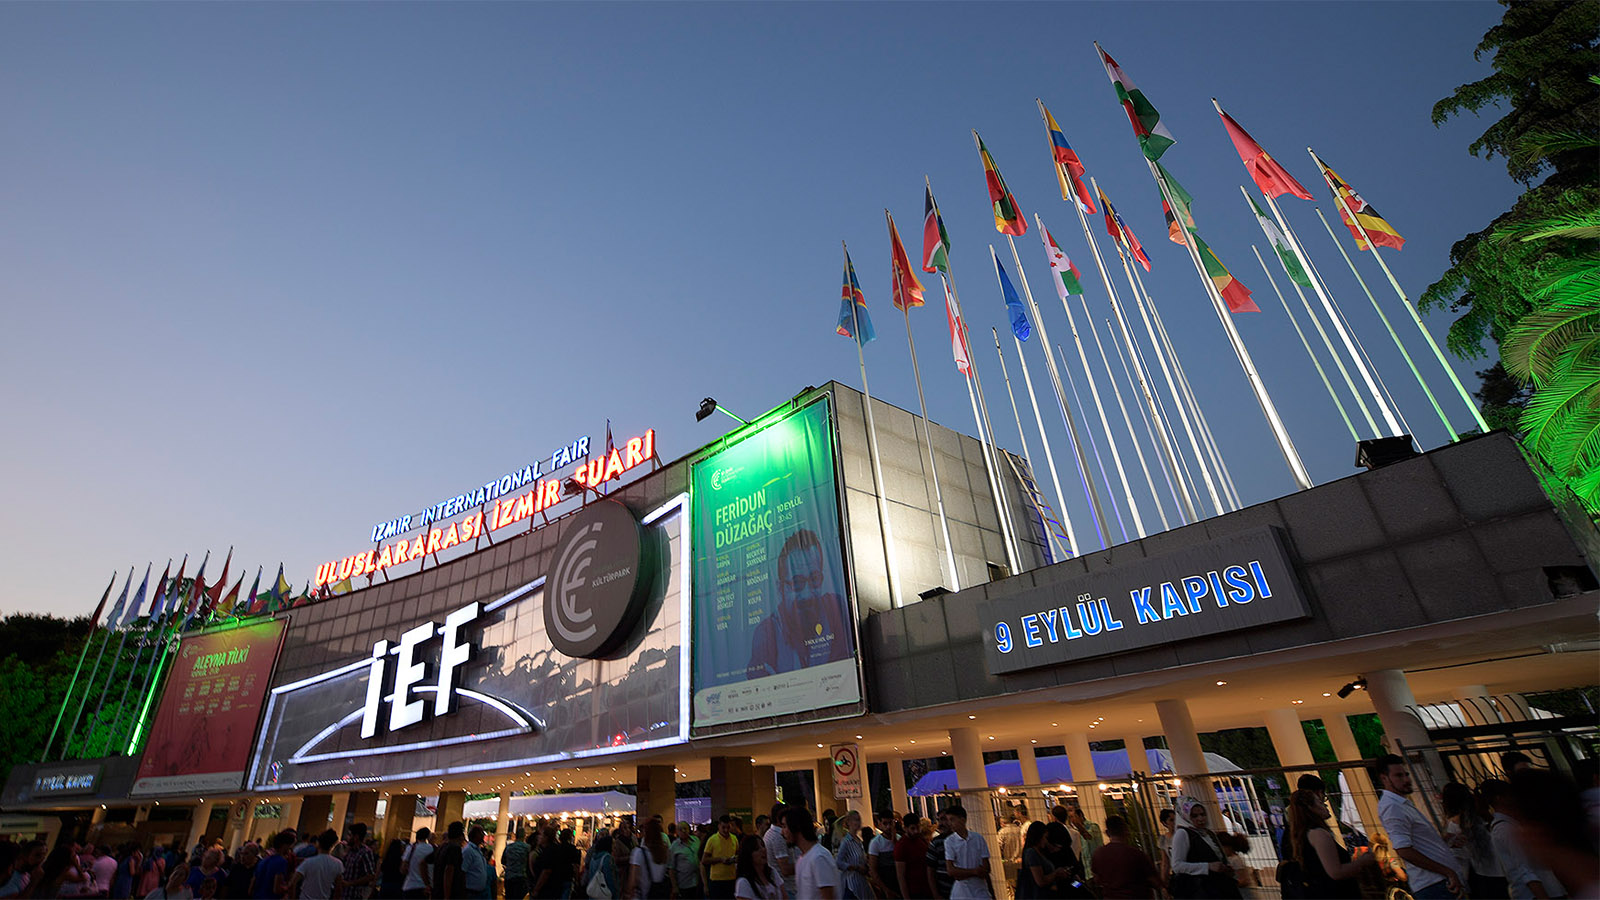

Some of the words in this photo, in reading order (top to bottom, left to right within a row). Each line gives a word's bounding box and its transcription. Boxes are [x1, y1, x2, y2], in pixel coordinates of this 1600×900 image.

[314, 511, 484, 587] ULUSLARARASI
[491, 479, 561, 531] İZMİR
[370, 514, 412, 543] IZMIR
[420, 461, 543, 527] INTERNATIONAL
[551, 435, 590, 471] FAIR
[715, 488, 766, 526] FERİDUN
[715, 510, 773, 549] DÜZAĞAÇ
[994, 621, 1014, 653] 9
[1021, 593, 1124, 649] EYLÜL
[1130, 560, 1273, 625] KAPISI
